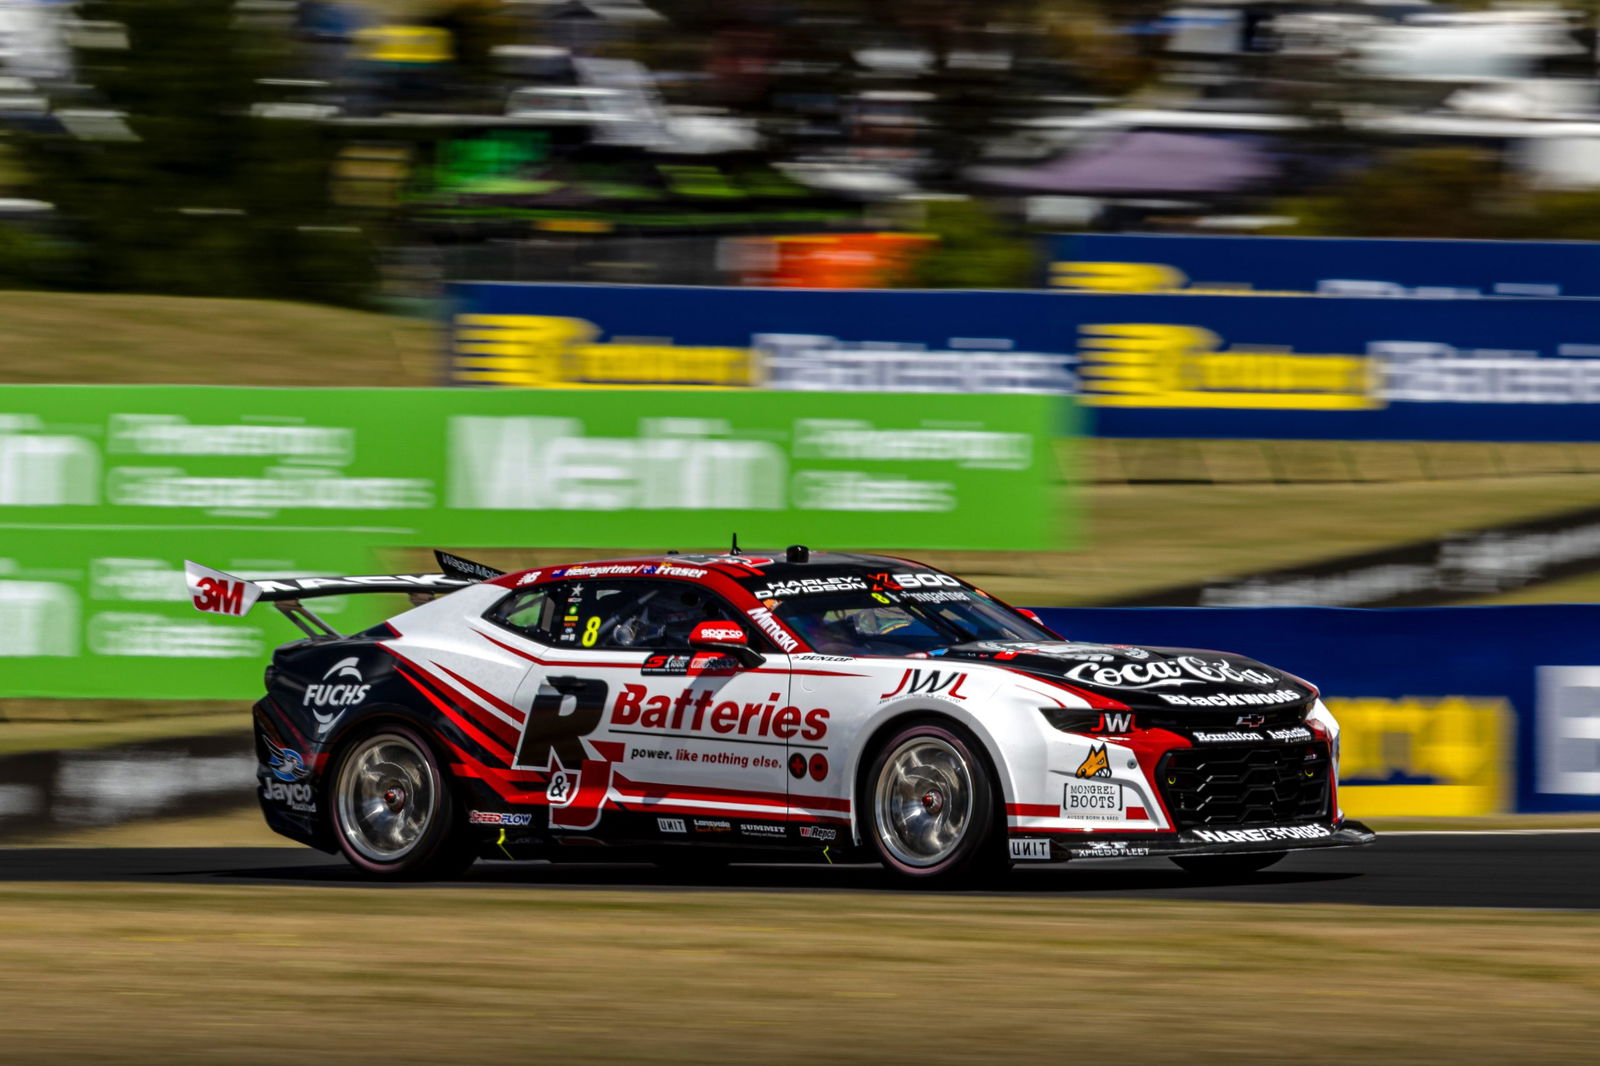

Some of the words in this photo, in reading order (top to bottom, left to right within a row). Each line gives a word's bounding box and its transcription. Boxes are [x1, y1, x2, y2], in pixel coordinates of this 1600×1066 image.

[655, 565, 708, 579] Fraser
[754, 582, 868, 600] DAVIDSON
[766, 576, 862, 590] HARLEY-
[192, 576, 246, 616] 3M
[582, 616, 601, 648] 8
[880, 668, 968, 700] JWL
[303, 684, 371, 706] FUCHS
[1158, 688, 1301, 707] Blackwoods
[610, 683, 830, 741] Batteries
[1192, 731, 1264, 742] Hamilton
[630, 748, 673, 761] power.
[675, 748, 699, 762] like
[701, 752, 749, 768] nothing
[752, 755, 783, 769] else.
[263, 777, 311, 805] Jayco
[1070, 784, 1116, 795] MONGREL
[1070, 795, 1115, 809] BOOTS
[740, 823, 786, 833] SUMMIT
